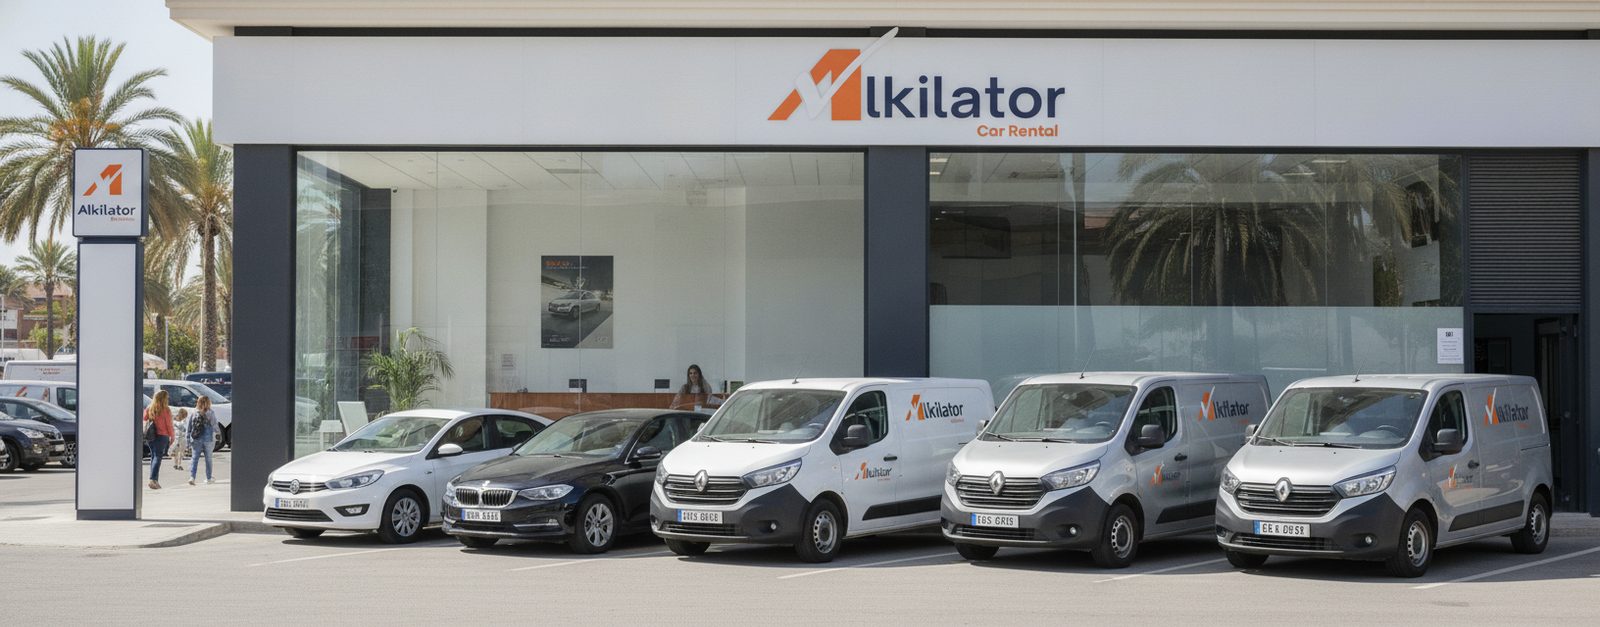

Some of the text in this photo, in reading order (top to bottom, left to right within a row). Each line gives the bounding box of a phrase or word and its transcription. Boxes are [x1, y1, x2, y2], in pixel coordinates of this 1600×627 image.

[976, 124, 1059, 137] Car Rental
[77, 203, 137, 216] Alkilator
